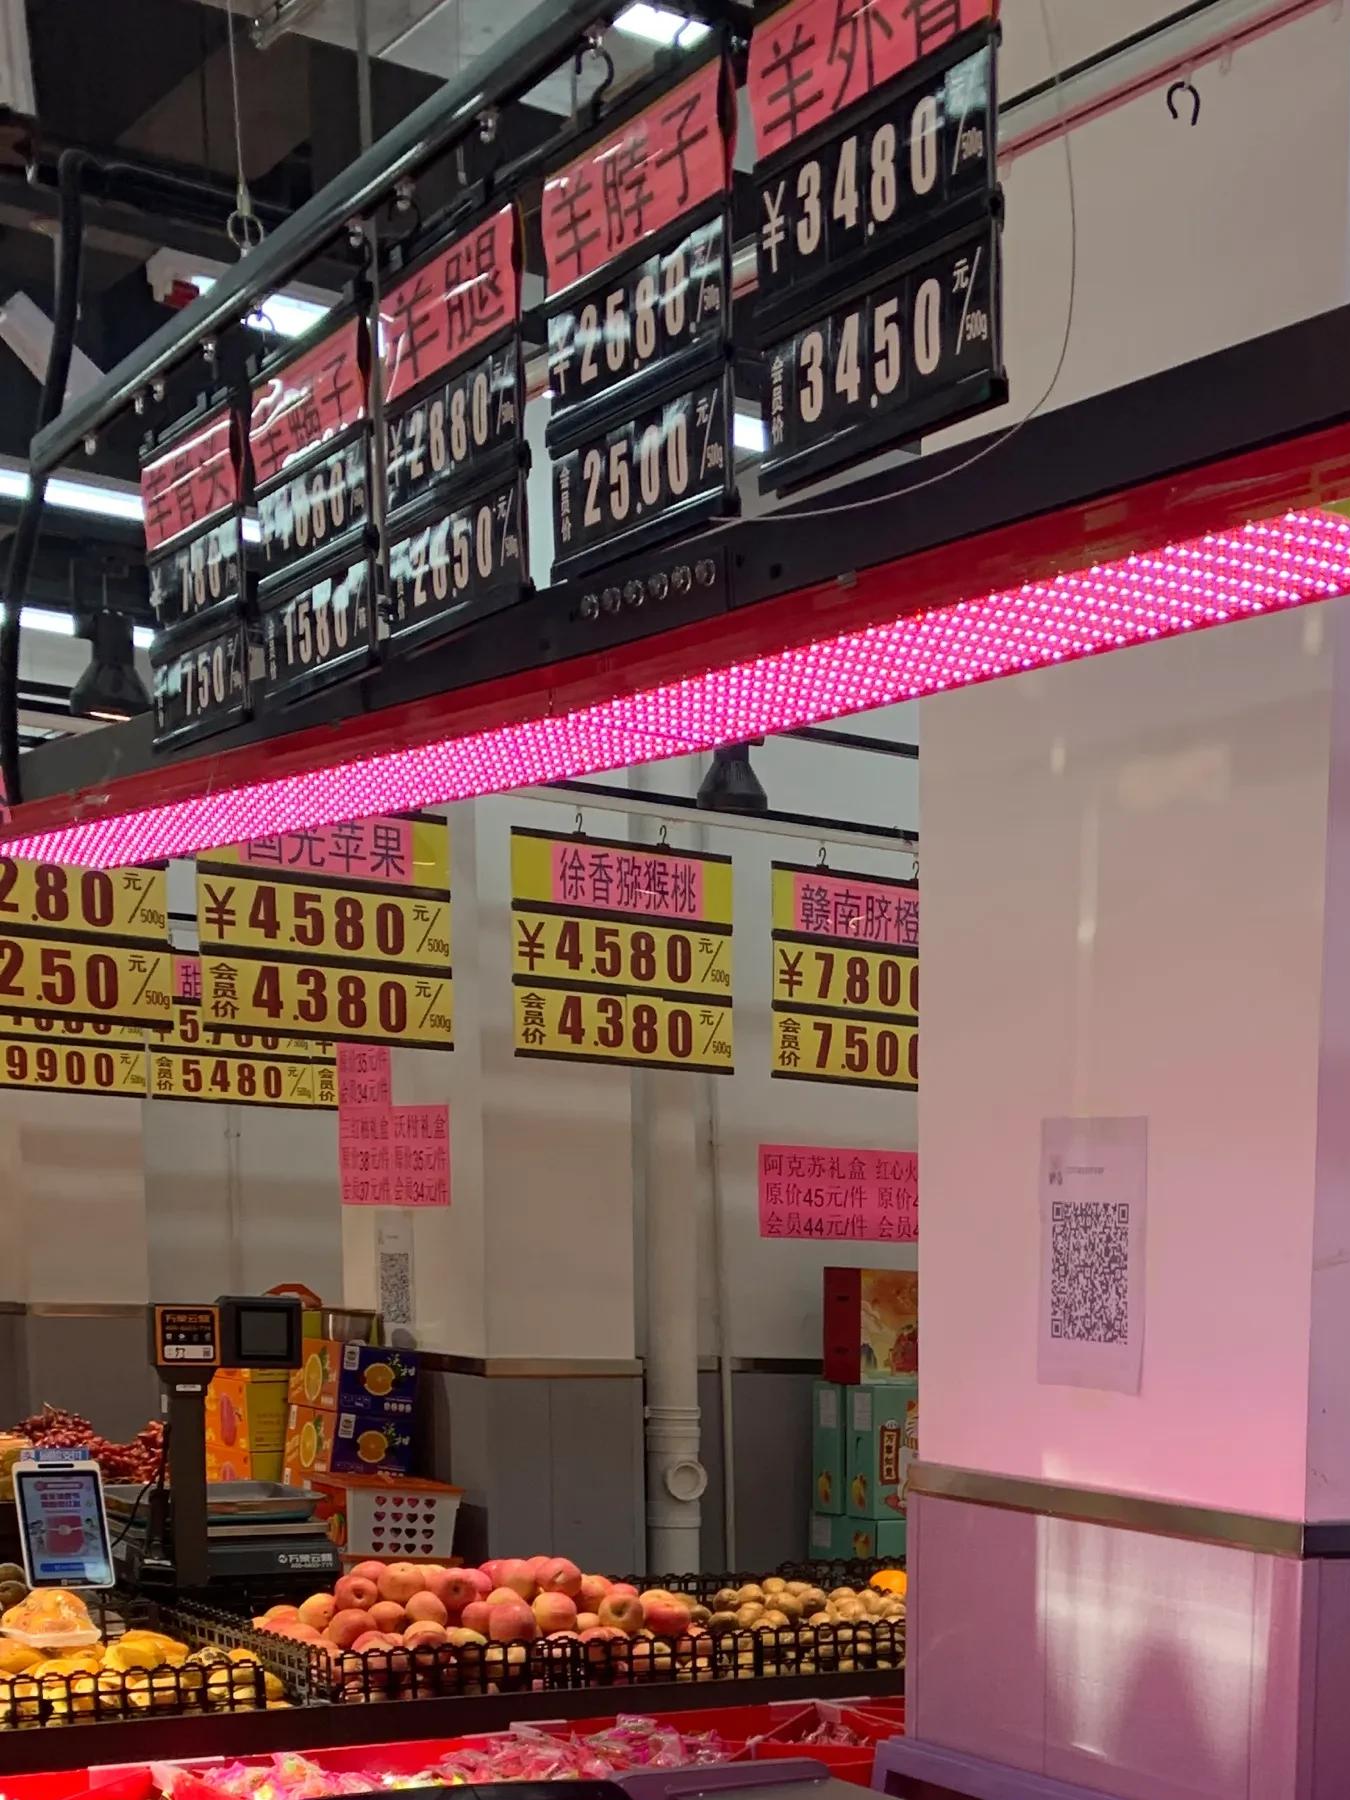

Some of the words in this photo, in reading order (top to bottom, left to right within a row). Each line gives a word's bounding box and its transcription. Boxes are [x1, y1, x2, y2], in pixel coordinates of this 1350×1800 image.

[556, 92, 708, 276] 羊脖子
[763, 96, 936, 272] ¥34.80
[391, 226, 506, 380] 羊腿
[800, 279, 940, 423] 34.50
[583, 413, 688, 526] 25.00
[559, 847, 697, 914] 徐香猕猴桃
[801, 884, 918, 944] 赣南脐橙
[209, 962, 240, 1020] 会员价
[520, 992, 547, 1045] 会员价
[779, 1017, 801, 1068] 会员价
[763, 1153, 867, 1181] 阿克苏礼盒
[766, 1182, 868, 1209] 原价45元/件
[767, 1211, 868, 1238] 会员44元/件
